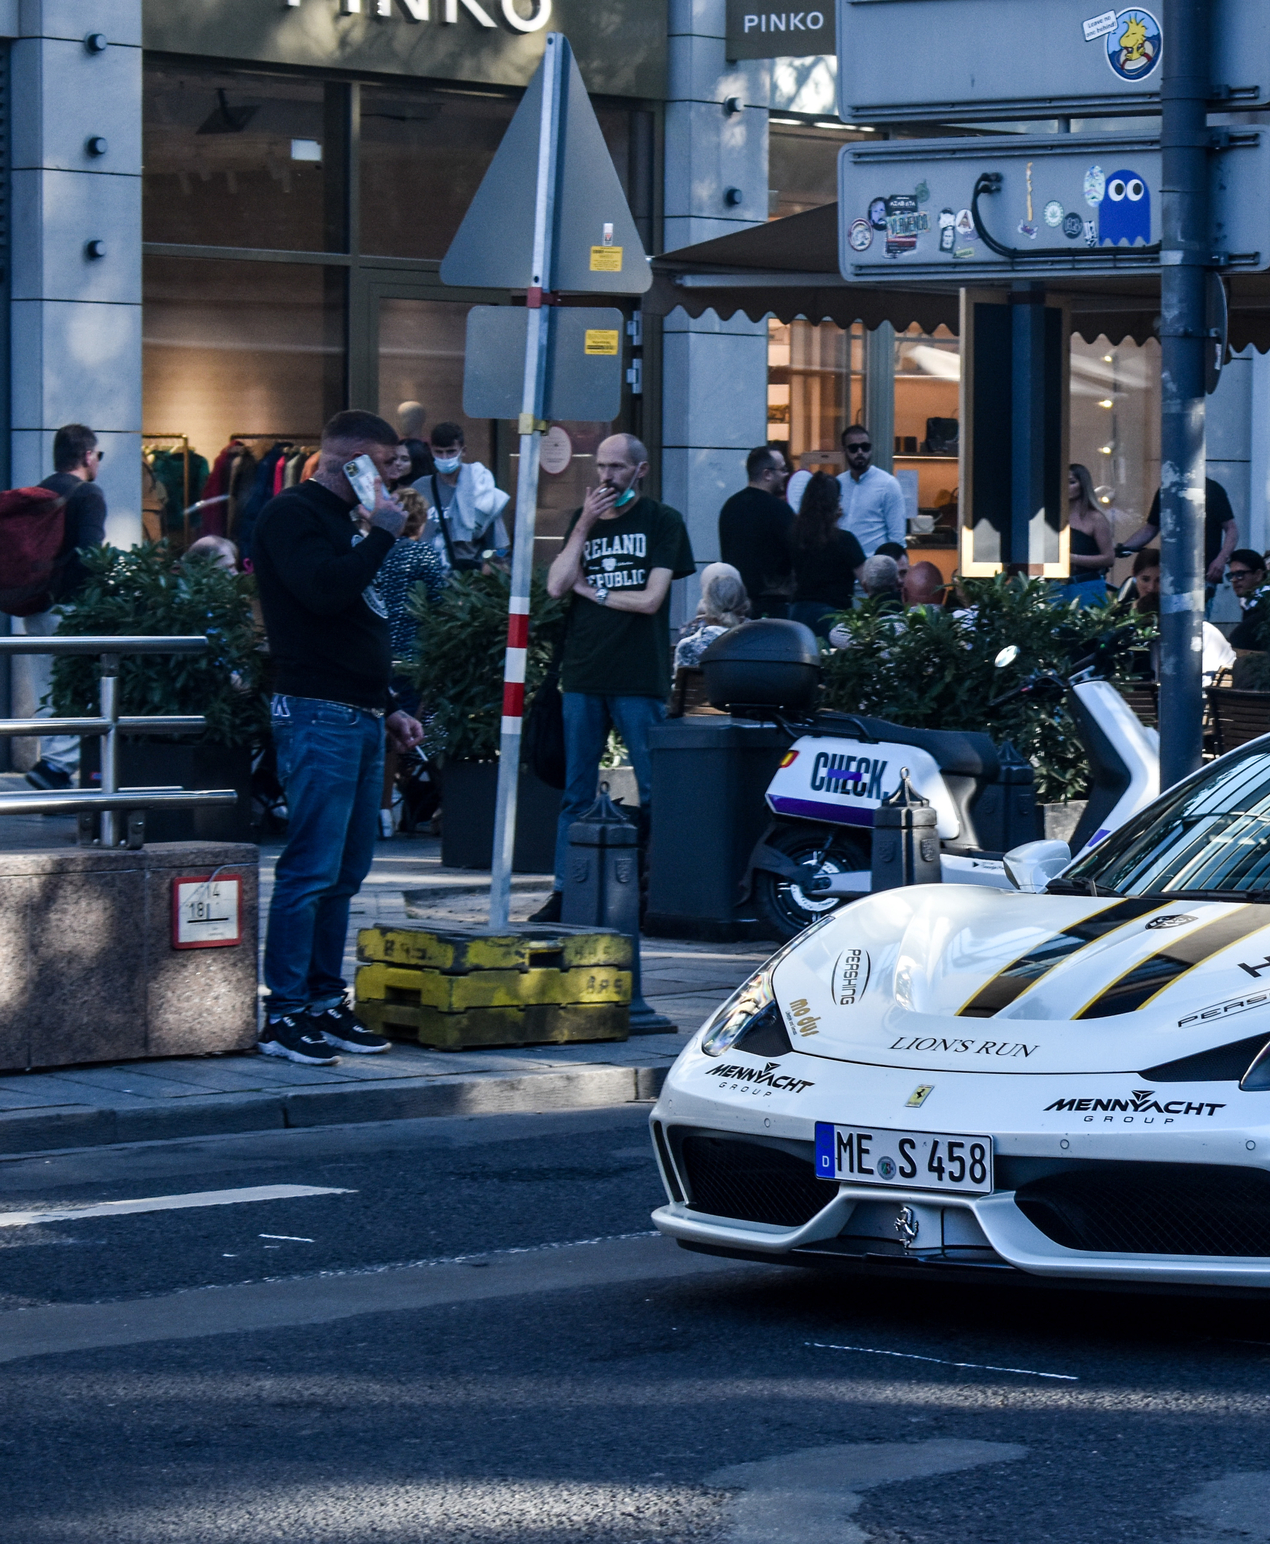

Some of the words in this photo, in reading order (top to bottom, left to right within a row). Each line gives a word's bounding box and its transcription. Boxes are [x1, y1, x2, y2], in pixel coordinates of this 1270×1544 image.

[744, 11, 824, 33] PINKO
[584, 533, 647, 561] RELAND
[586, 569, 646, 588] EPUBLIC
[840, 949, 862, 1006] PERSHING
[888, 1037, 976, 1054] LION'S
[973, 1040, 1041, 1058] RUN
[704, 1063, 816, 1094] MENNYACHT
[718, 1081, 773, 1098] GROUP
[1042, 1097, 1228, 1116] MENNYACHT
[1083, 1115, 1175, 1125] GROUP
[821, 1155, 830, 1168] D
[836, 1131, 875, 1175] ME
[898, 1138, 917, 1179] S
[927, 1138, 987, 1184] 458
